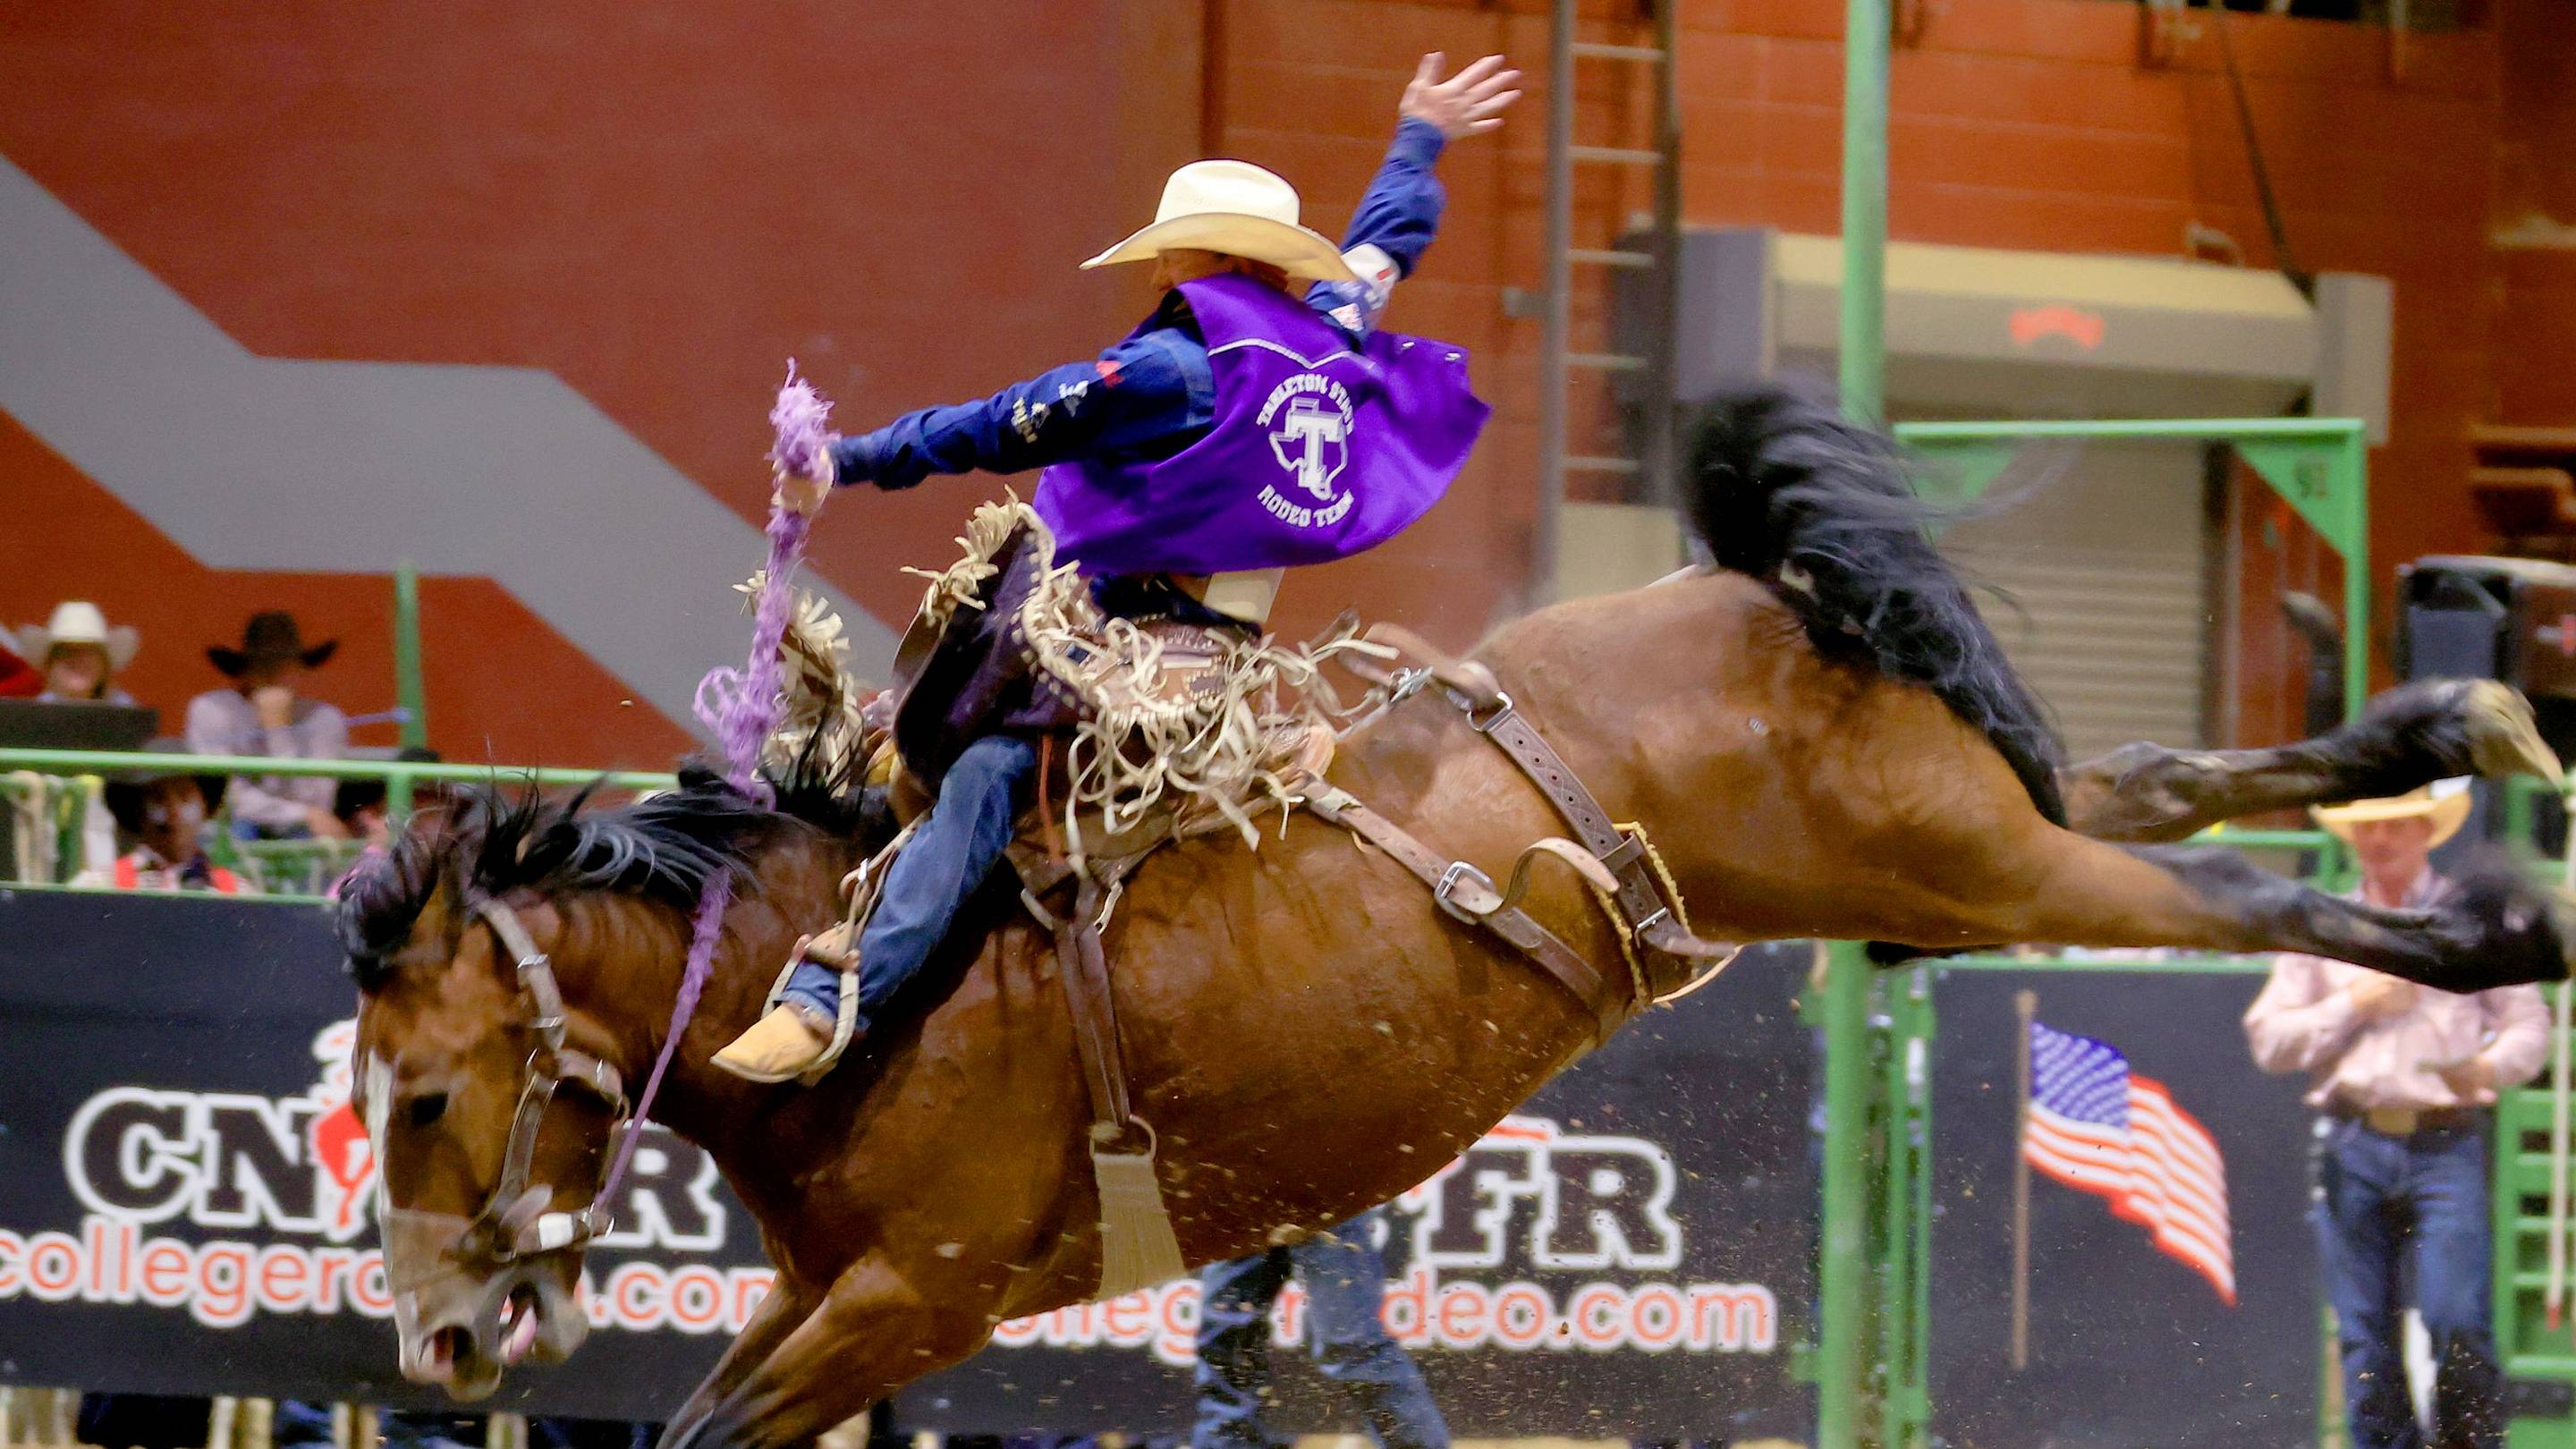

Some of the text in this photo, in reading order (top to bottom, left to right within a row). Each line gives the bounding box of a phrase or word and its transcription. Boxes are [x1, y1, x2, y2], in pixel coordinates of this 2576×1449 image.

[1257, 484, 1354, 528] RODEO TEAM
[64, 1086, 726, 1250] CNR
[1411, 1134, 1682, 1270] FR
[0, 1215, 777, 1336] ollegero.co
[991, 1261, 1778, 1364] egrdeo.com
